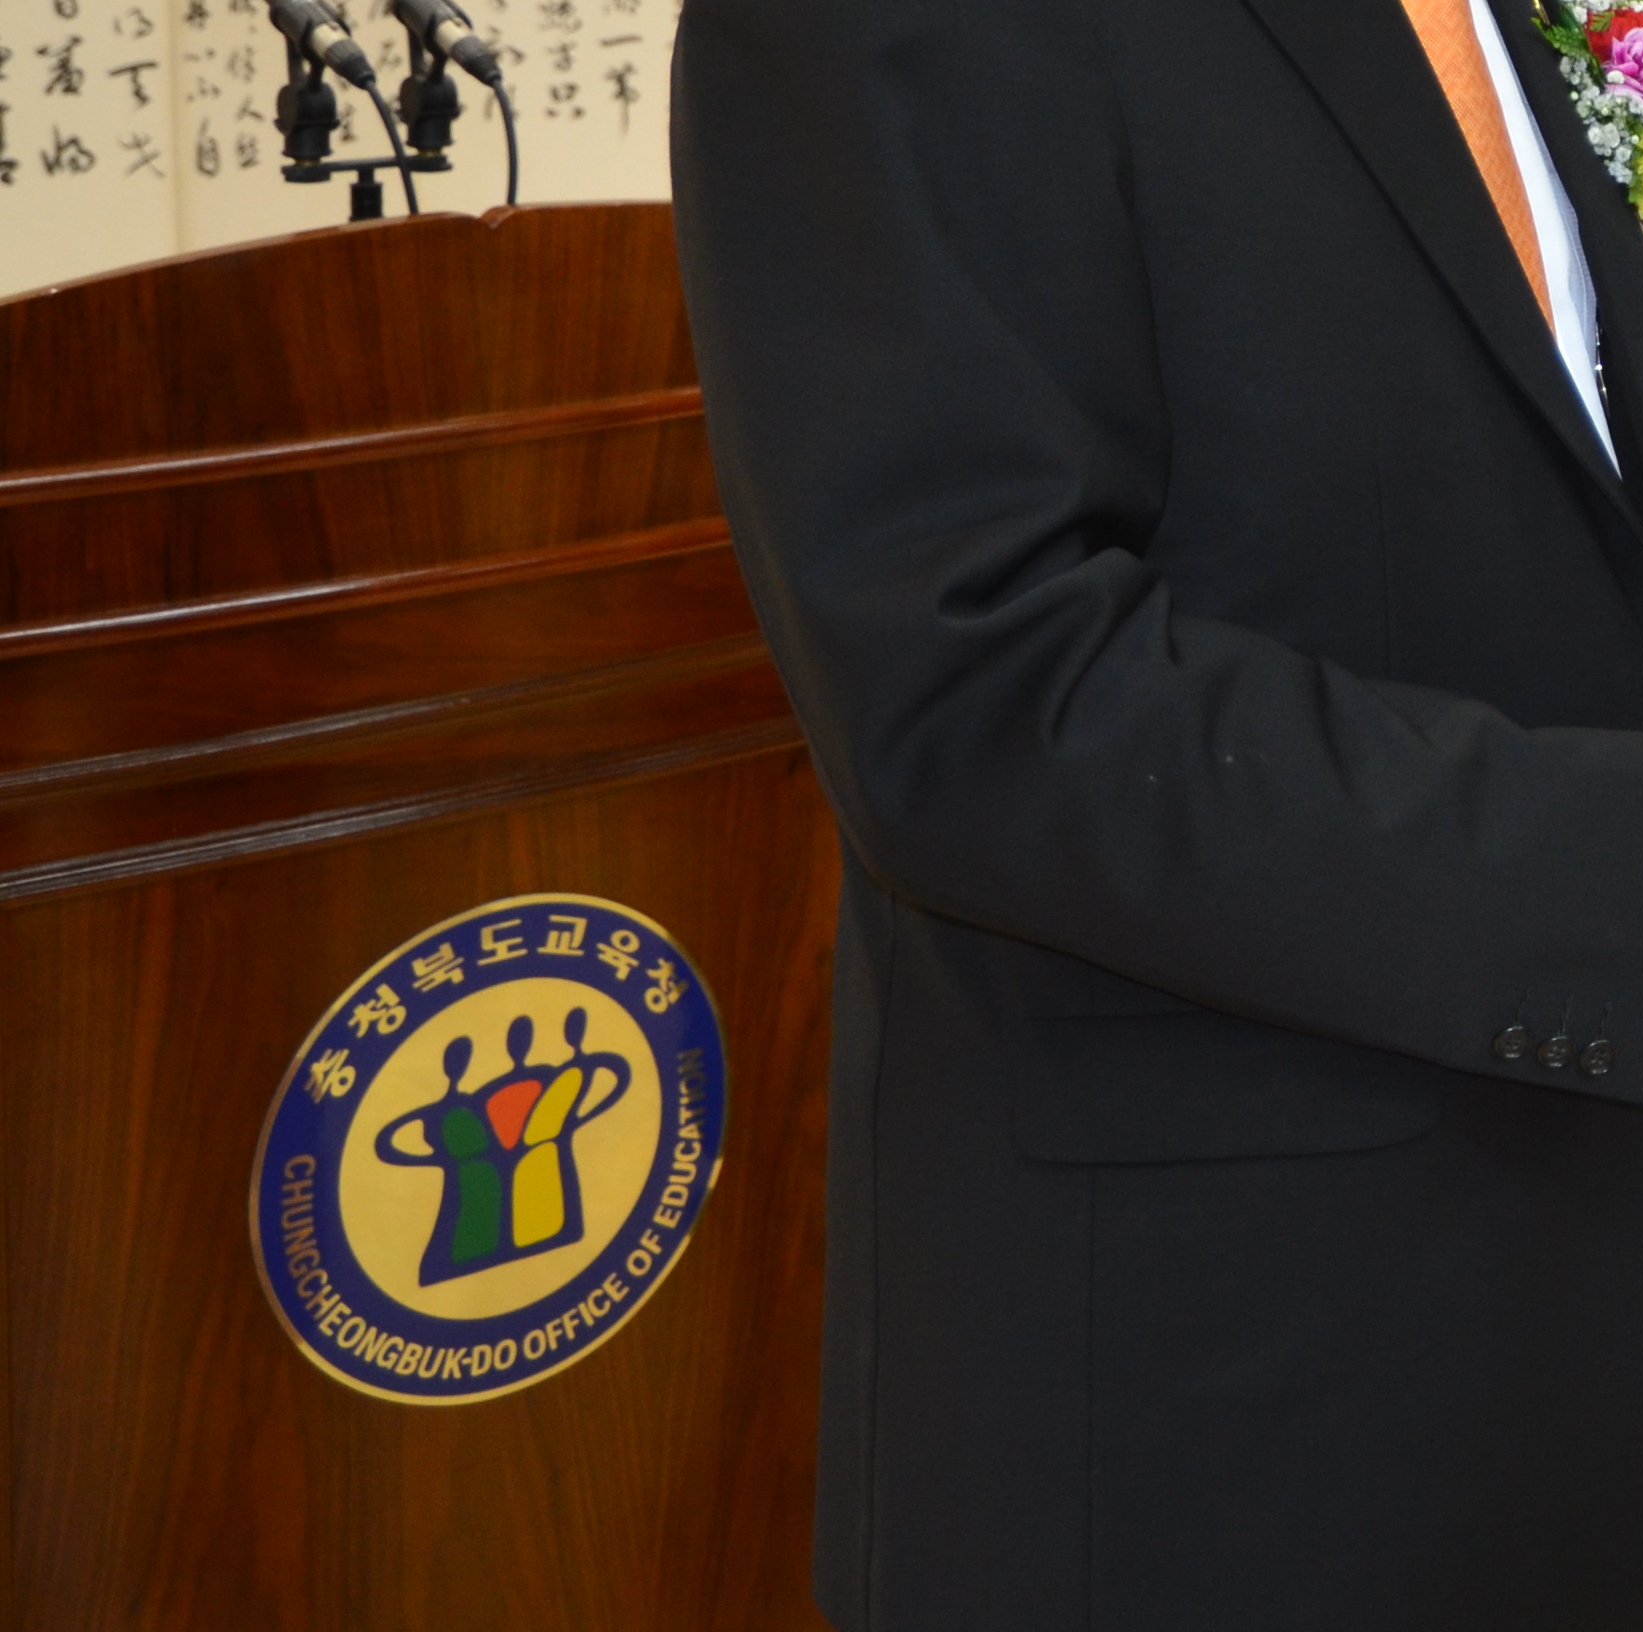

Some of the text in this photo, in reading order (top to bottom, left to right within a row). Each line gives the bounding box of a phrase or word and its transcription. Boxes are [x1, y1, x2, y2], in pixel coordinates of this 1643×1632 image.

[304, 914, 689, 1104] 충청북도교육청
[280, 1048, 706, 1380] CHUNGCHEONGBUK-DO OFFICE OF EDUCATION
